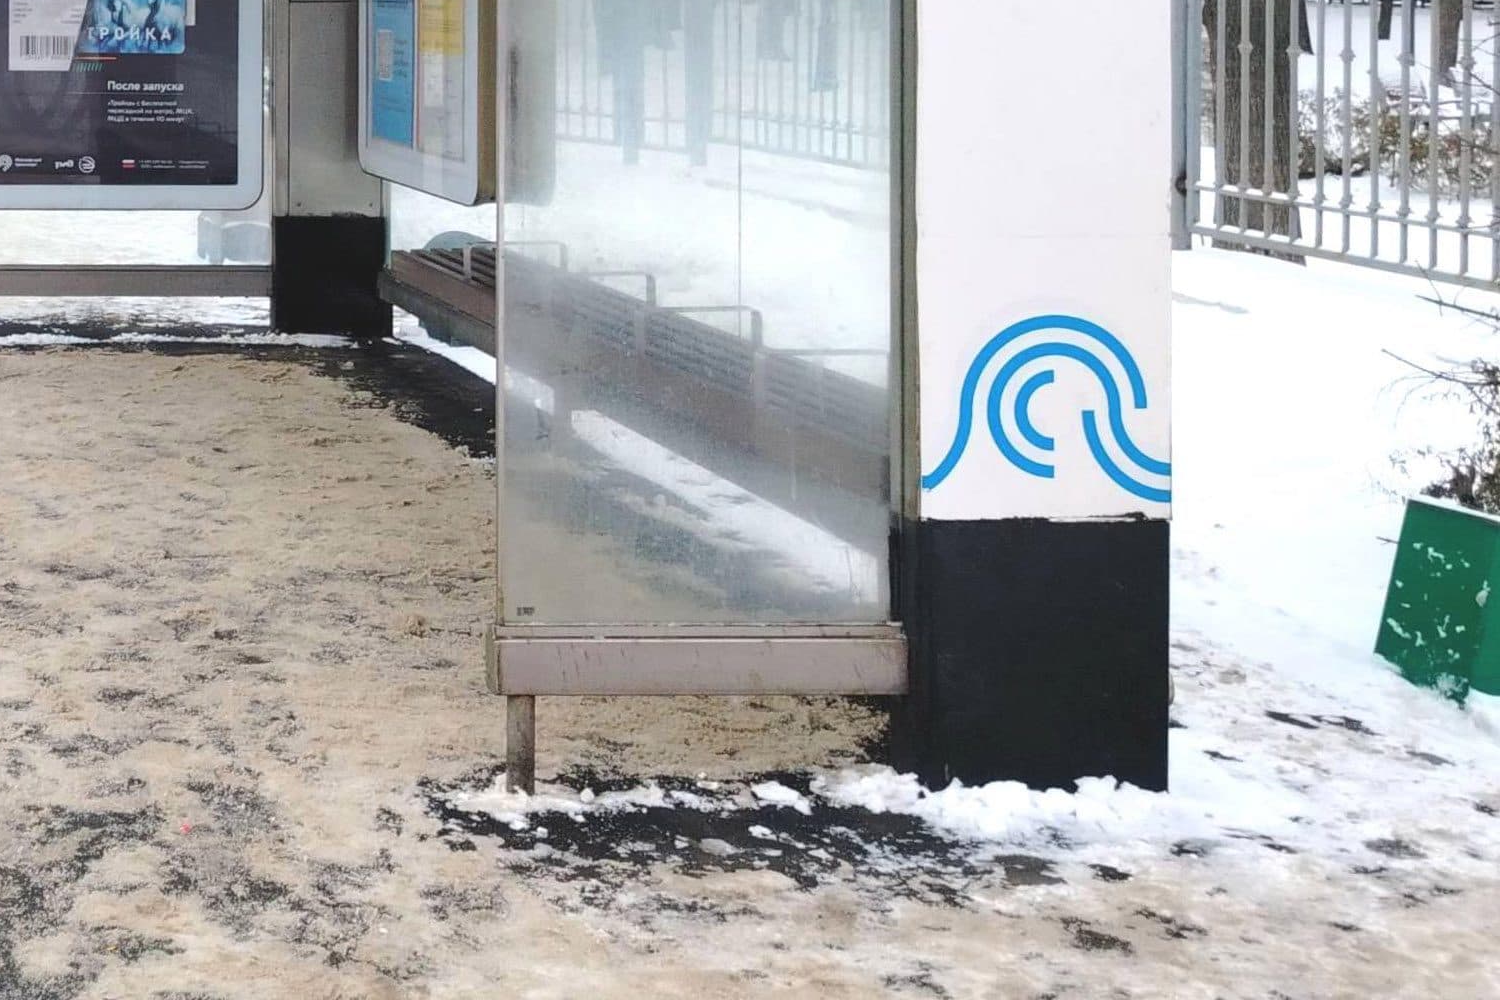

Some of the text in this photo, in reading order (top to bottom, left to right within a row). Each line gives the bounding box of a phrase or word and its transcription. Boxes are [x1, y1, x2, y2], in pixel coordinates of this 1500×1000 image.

[87, 24, 172, 41] ТРОЙКА
[107, 80, 184, 93] После запуска
